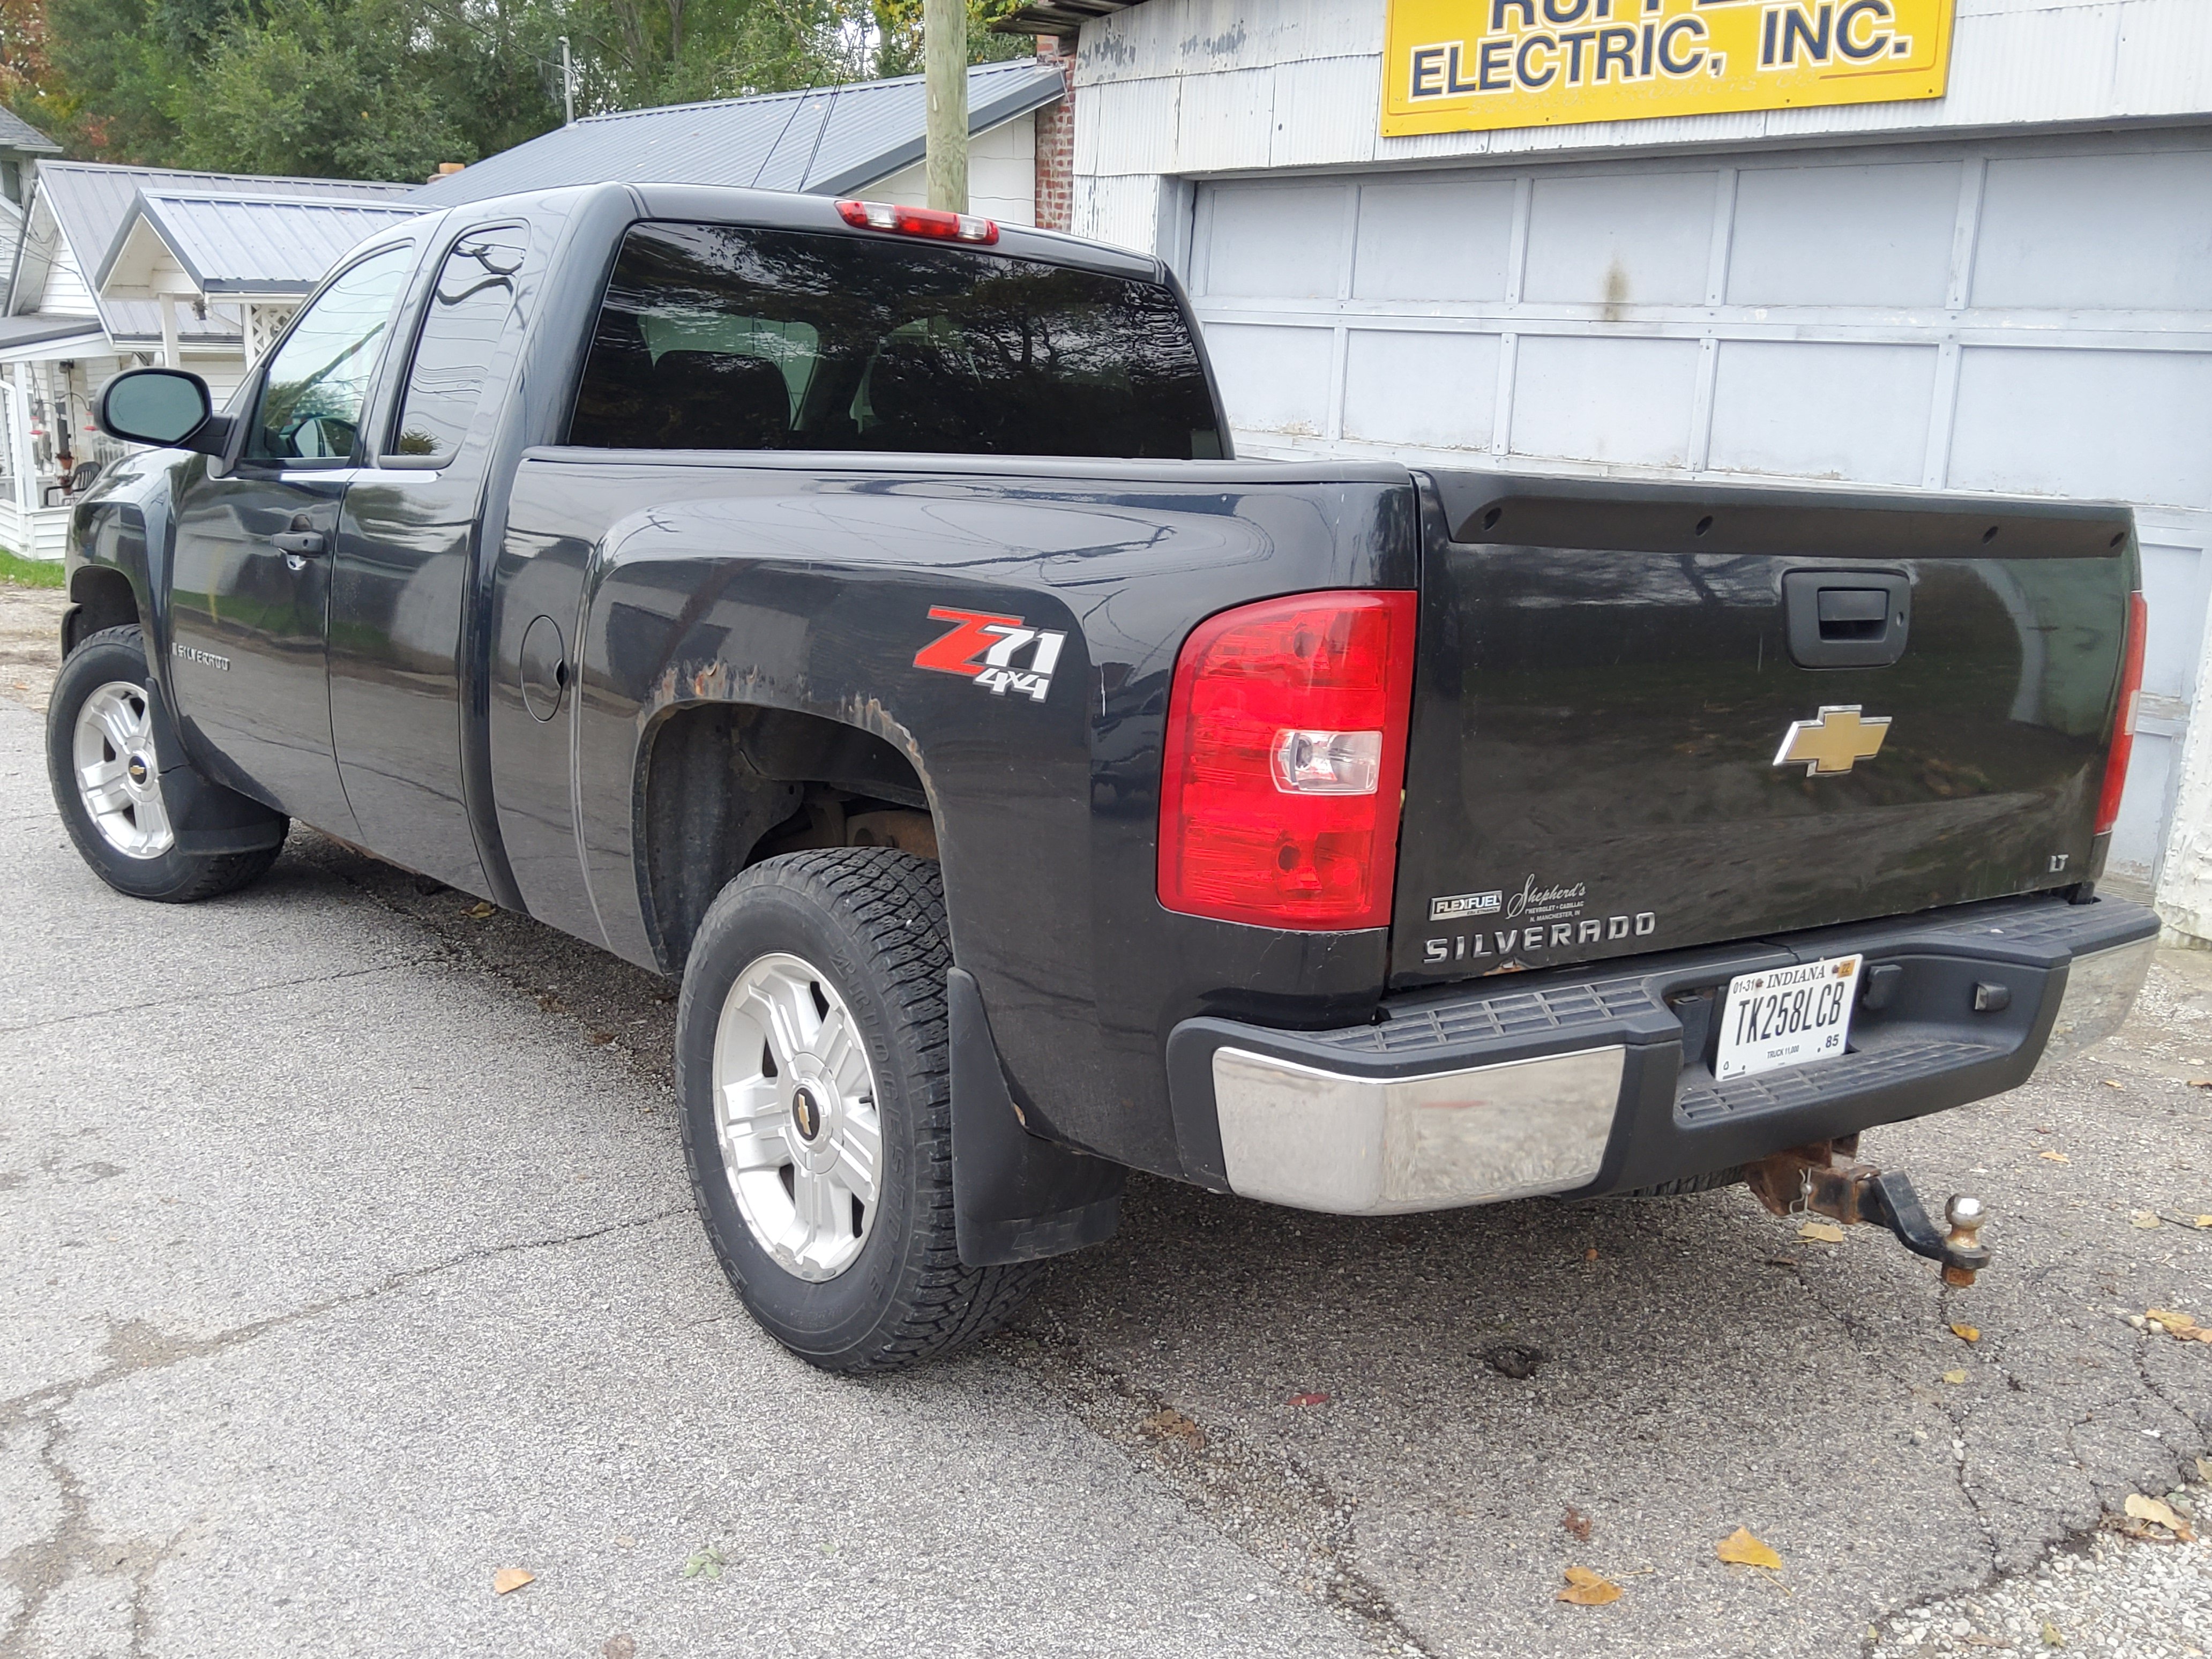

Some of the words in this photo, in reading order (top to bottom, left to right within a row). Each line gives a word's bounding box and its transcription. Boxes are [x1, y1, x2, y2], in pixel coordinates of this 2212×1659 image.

[1410, 17, 1723, 99] ELECTRIC,
[1760, 1, 1910, 69] INC.
[913, 606, 1066, 676] Z71
[177, 645, 230, 670] SILVERADO
[2049, 854, 2069, 872] LT
[1505, 873, 1586, 920] Shepherd's
[1525, 905, 1556, 914] CHEVROLET
[1559, 901, 1585, 910] CADILLAC
[1423, 912, 1655, 963] SILVERADO
[1732, 978, 1755, 995] 01-31
[1766, 965, 1825, 989] INDIANA
[1735, 981, 1845, 1046] TK258LCB
[1767, 1048, 1784, 1059] TRUCK
[1784, 1045, 1800, 1055] 11,000
[1825, 1034, 1840, 1048] 85
